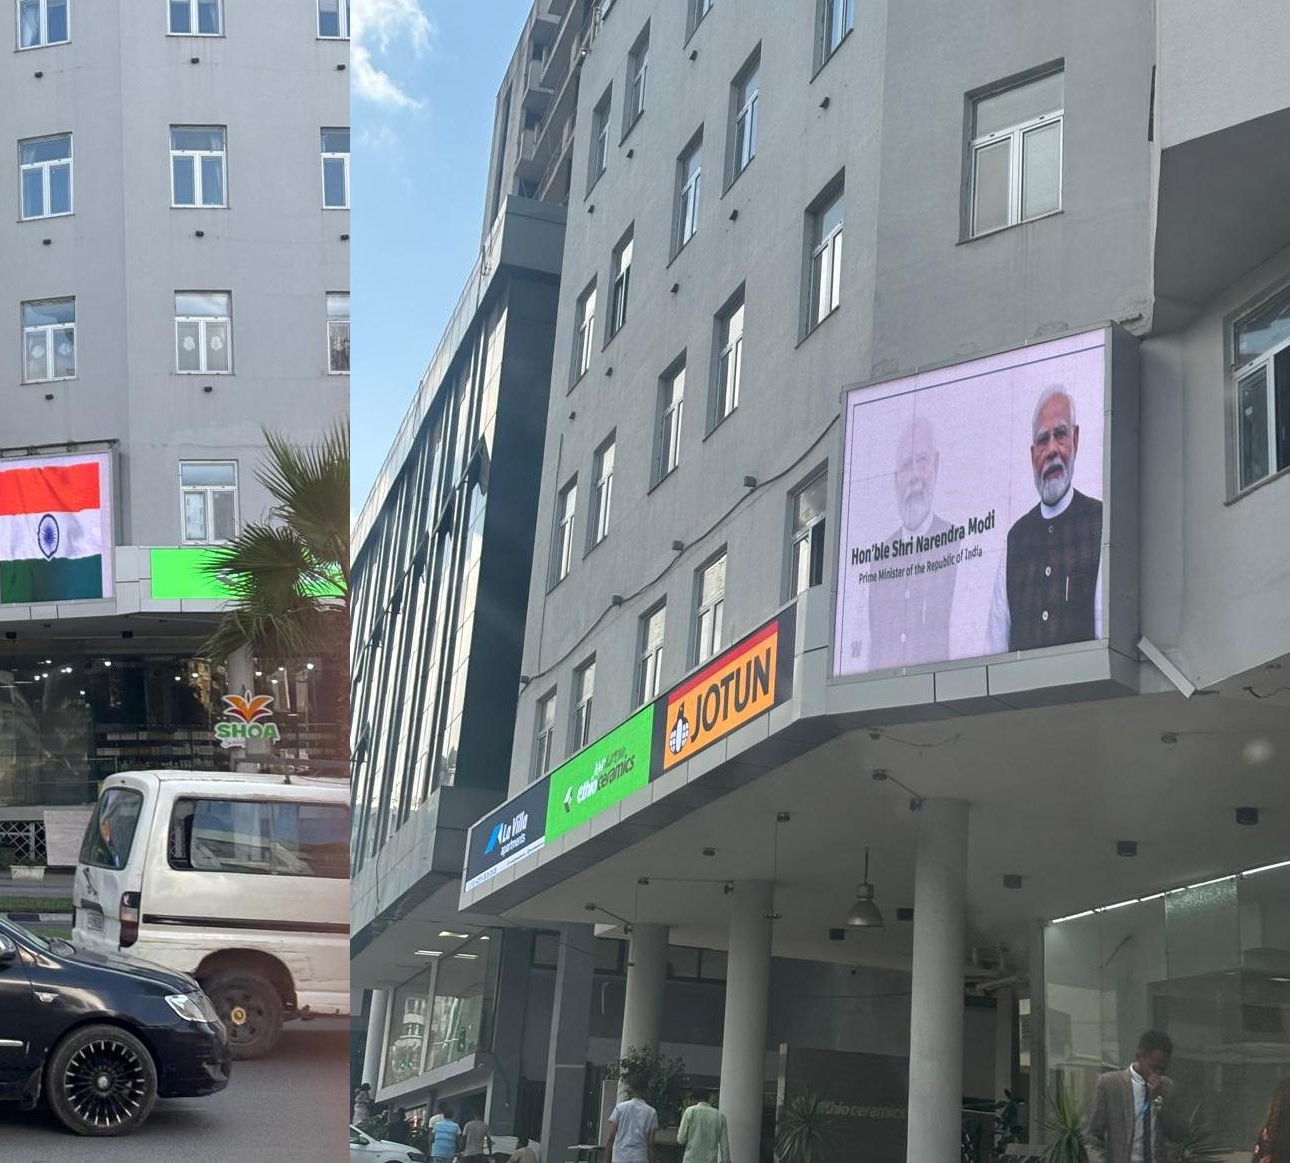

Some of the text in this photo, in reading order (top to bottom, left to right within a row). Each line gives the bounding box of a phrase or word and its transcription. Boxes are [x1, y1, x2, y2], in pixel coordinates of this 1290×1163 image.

[851, 509, 995, 565] Hon'ble Shri Narendra Modi
[859, 545, 982, 584] Prime Minister of the Republic of India
[690, 647, 771, 743] JOTUN
[215, 722, 279, 740] SHOA
